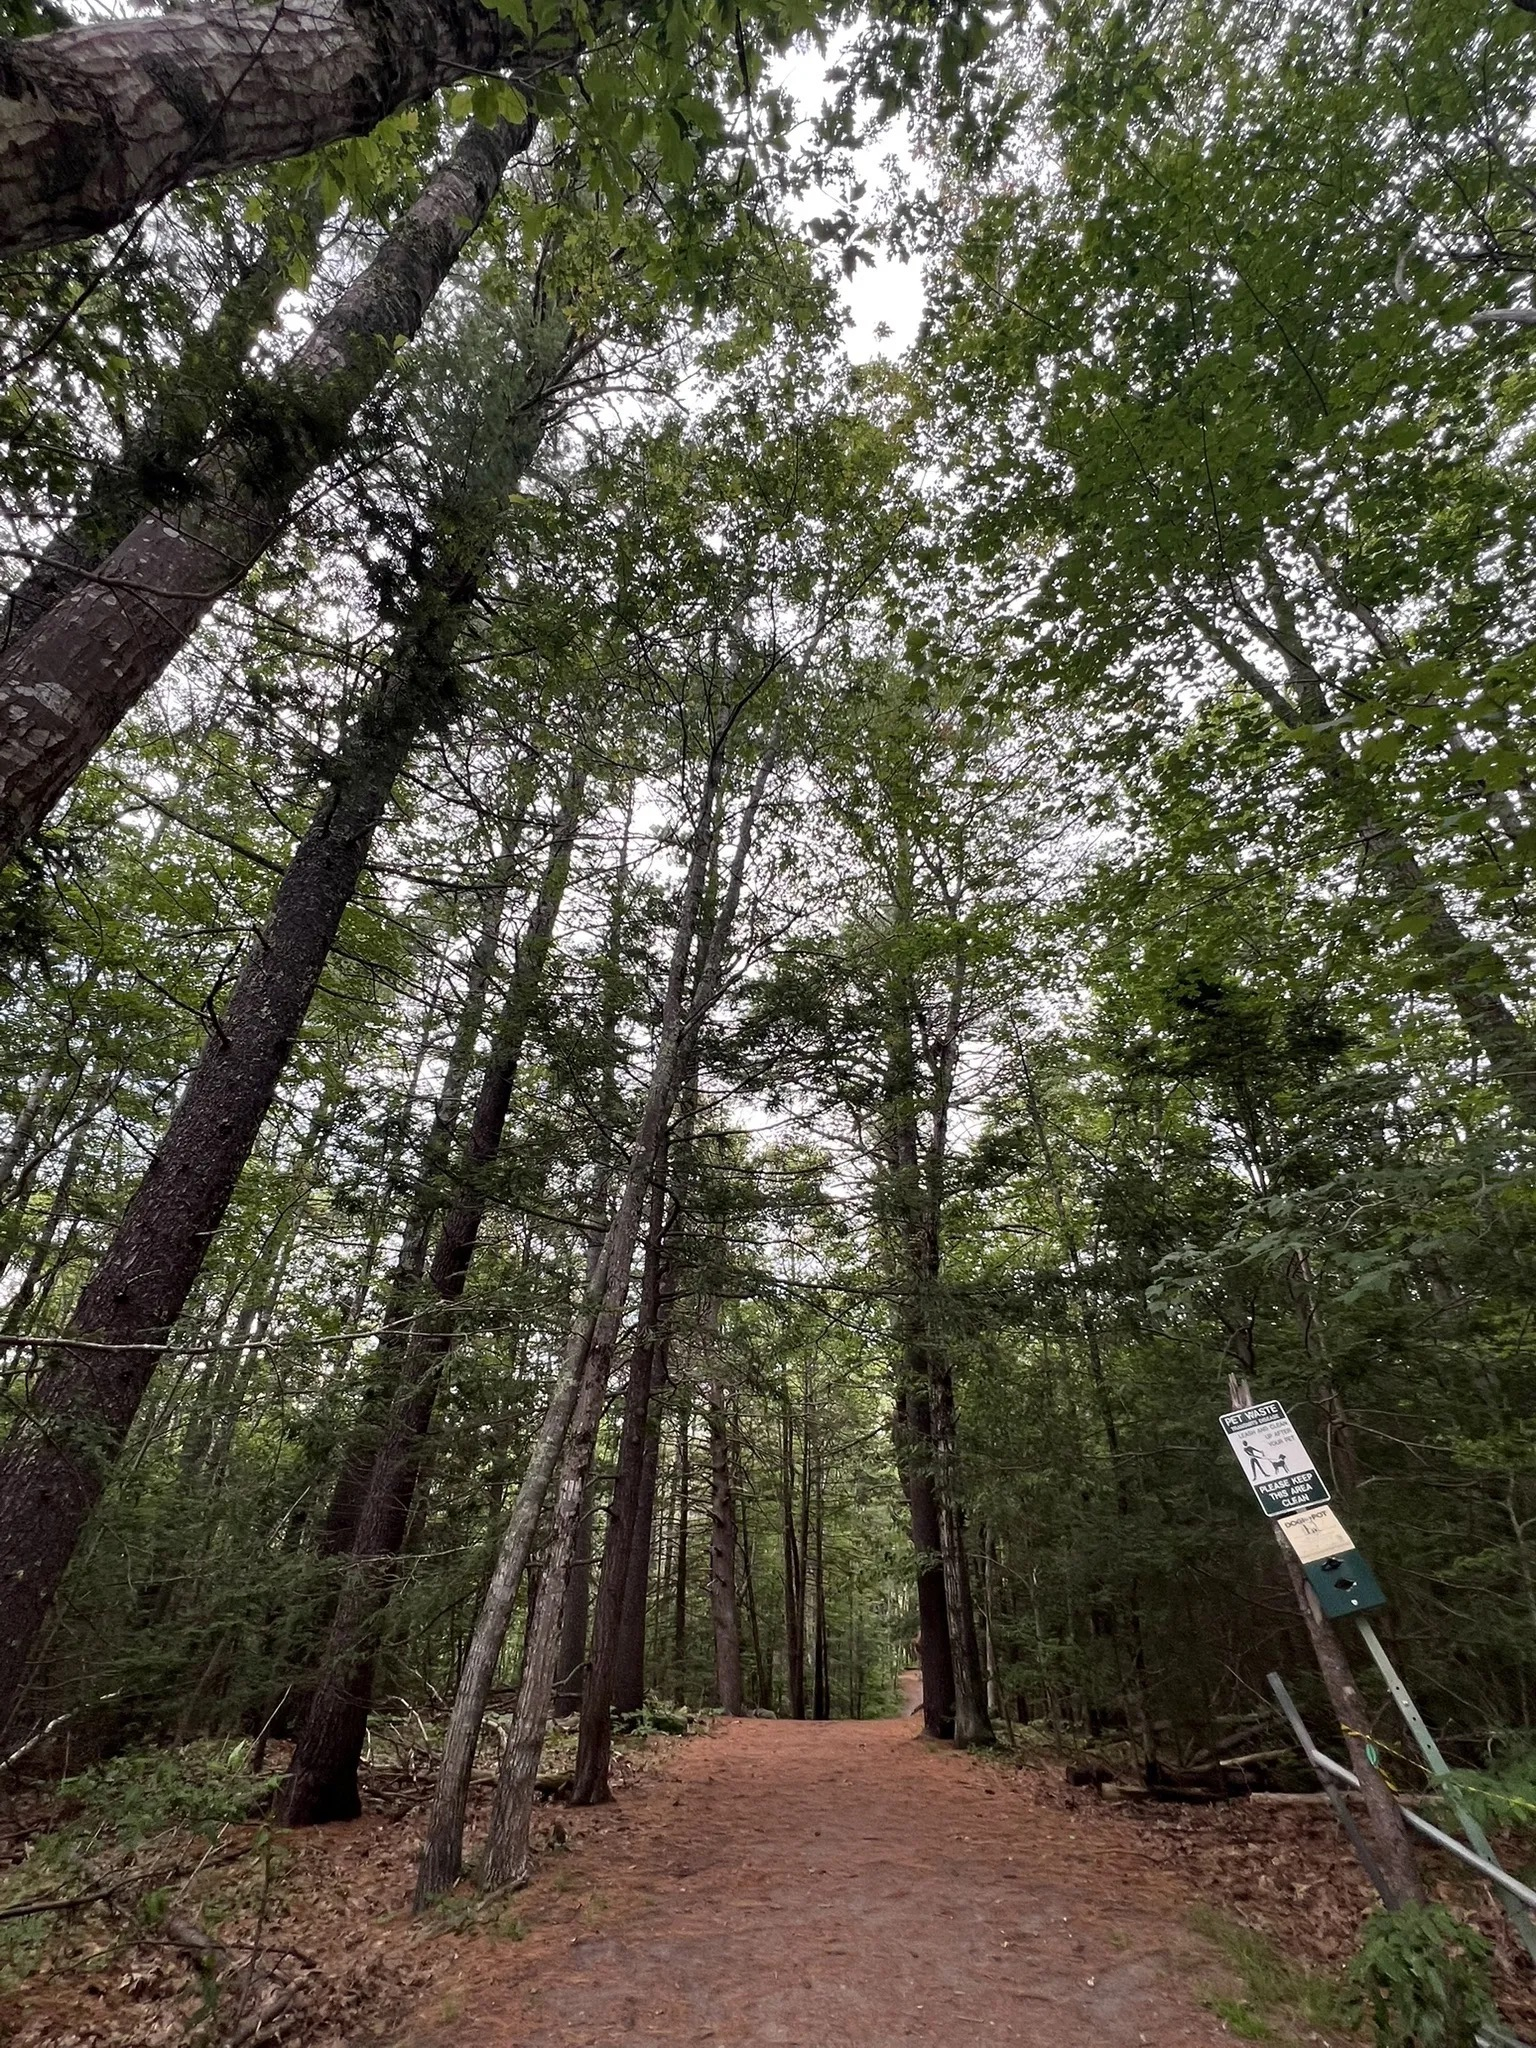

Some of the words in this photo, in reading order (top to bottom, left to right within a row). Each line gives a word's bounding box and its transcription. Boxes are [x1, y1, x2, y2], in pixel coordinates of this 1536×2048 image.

[1224, 1415, 1243, 1427] PET
[1244, 1404, 1279, 1420] WASTE
[1259, 1413, 1280, 1424] DISEASE
[1238, 1430, 1256, 1439] LEASH
[1257, 1426, 1269, 1434] AND
[1269, 1421, 1288, 1430] CLEAN
[1274, 1428, 1292, 1437] AFTER
[1268, 1439, 1285, 1447] YOUR
[1285, 1435, 1296, 1443] PET
[1259, 1479, 1291, 1494] PLEASE
[1291, 1473, 1313, 1484] KEEP
[1269, 1490, 1289, 1501] THIS
[1290, 1484, 1313, 1495] AREA
[1281, 1494, 1310, 1507] CLEAN
